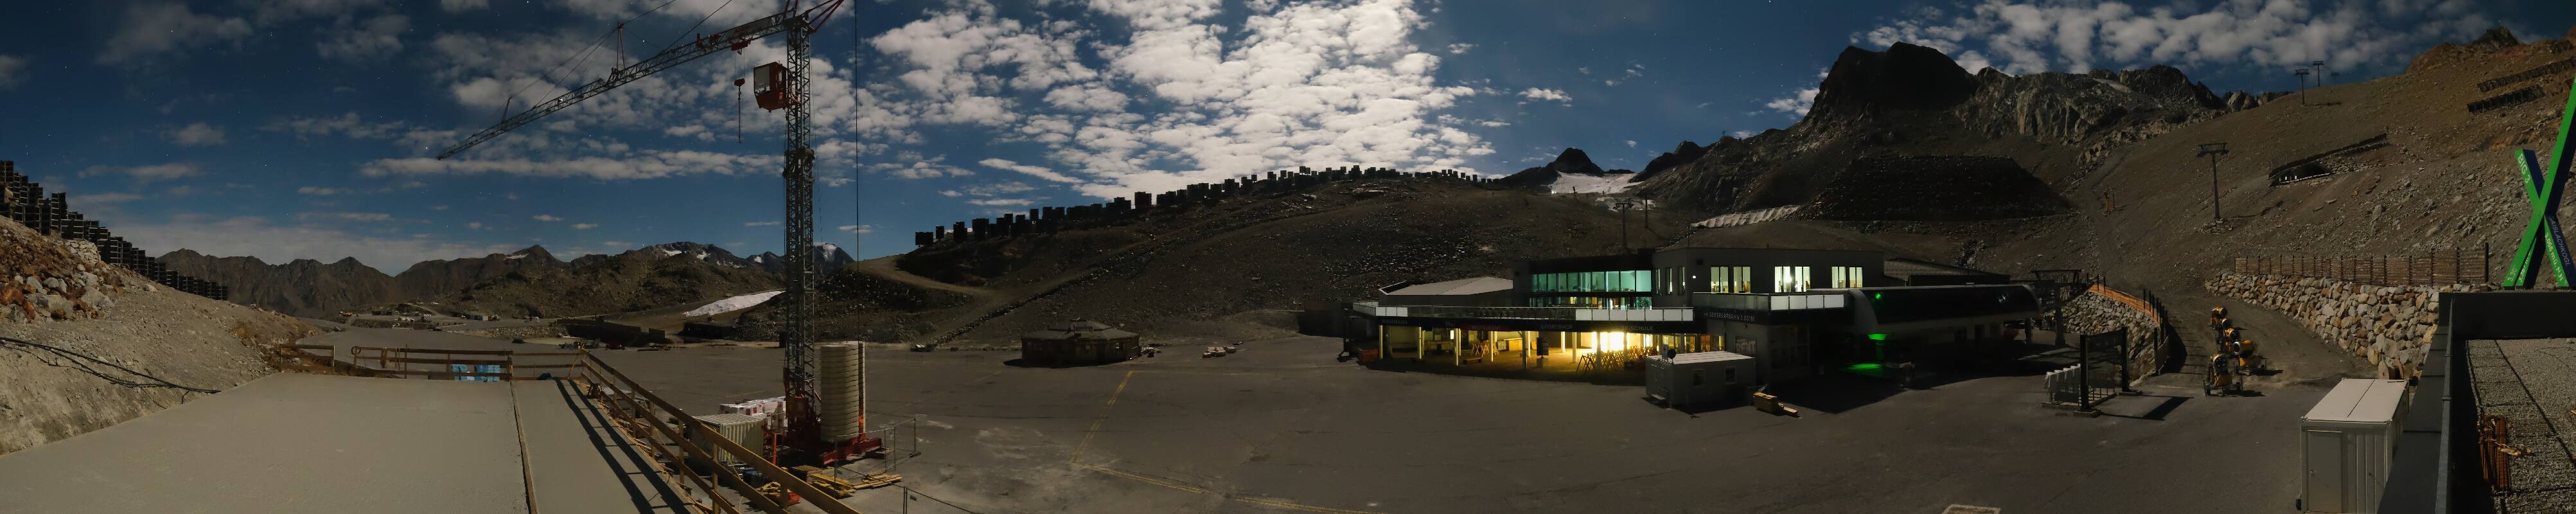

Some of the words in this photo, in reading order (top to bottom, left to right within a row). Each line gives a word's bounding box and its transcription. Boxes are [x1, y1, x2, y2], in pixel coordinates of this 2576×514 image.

[2518, 153, 2527, 175] BIG
[2525, 175, 2530, 184] 3
[2549, 216, 2570, 266] GAISLACHKOGL
